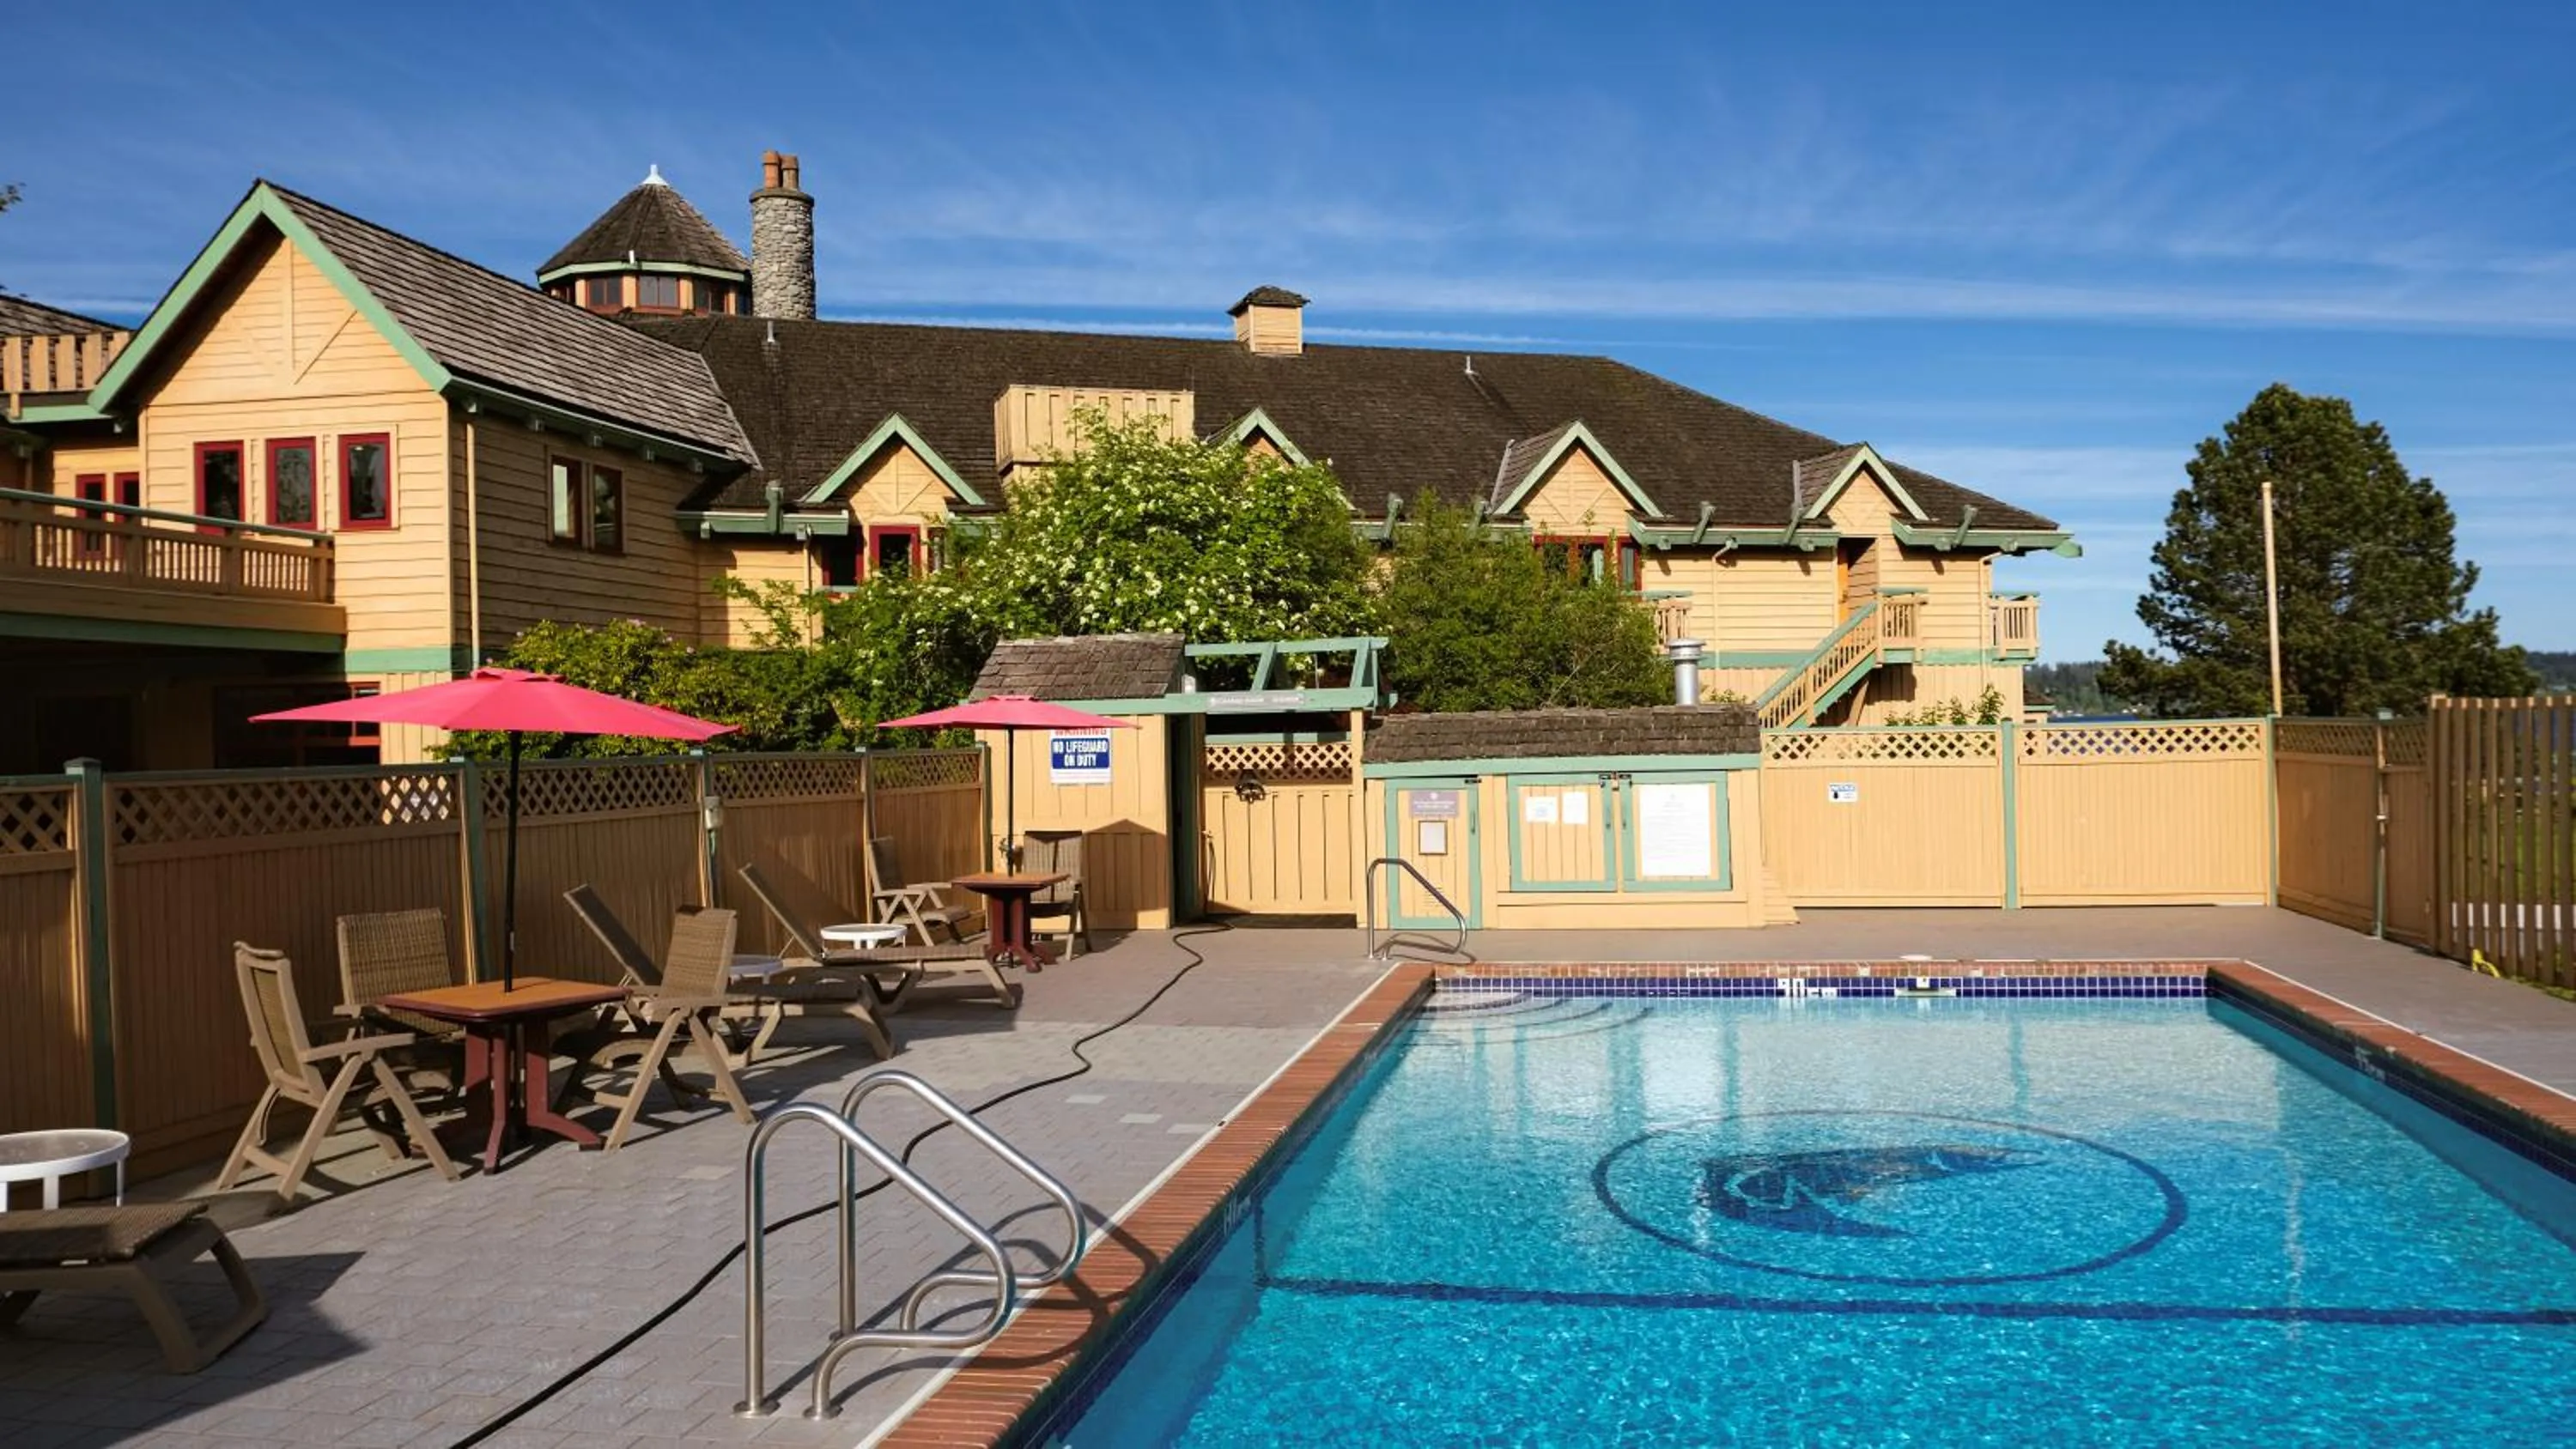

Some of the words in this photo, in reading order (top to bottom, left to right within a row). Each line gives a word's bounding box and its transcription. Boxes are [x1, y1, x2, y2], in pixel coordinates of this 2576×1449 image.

[1053, 741, 1064, 753] NO
[1066, 740, 1108, 753] LIFEGUARD
[1065, 754, 1075, 767] ON
[1077, 754, 1097, 767] DUTY
